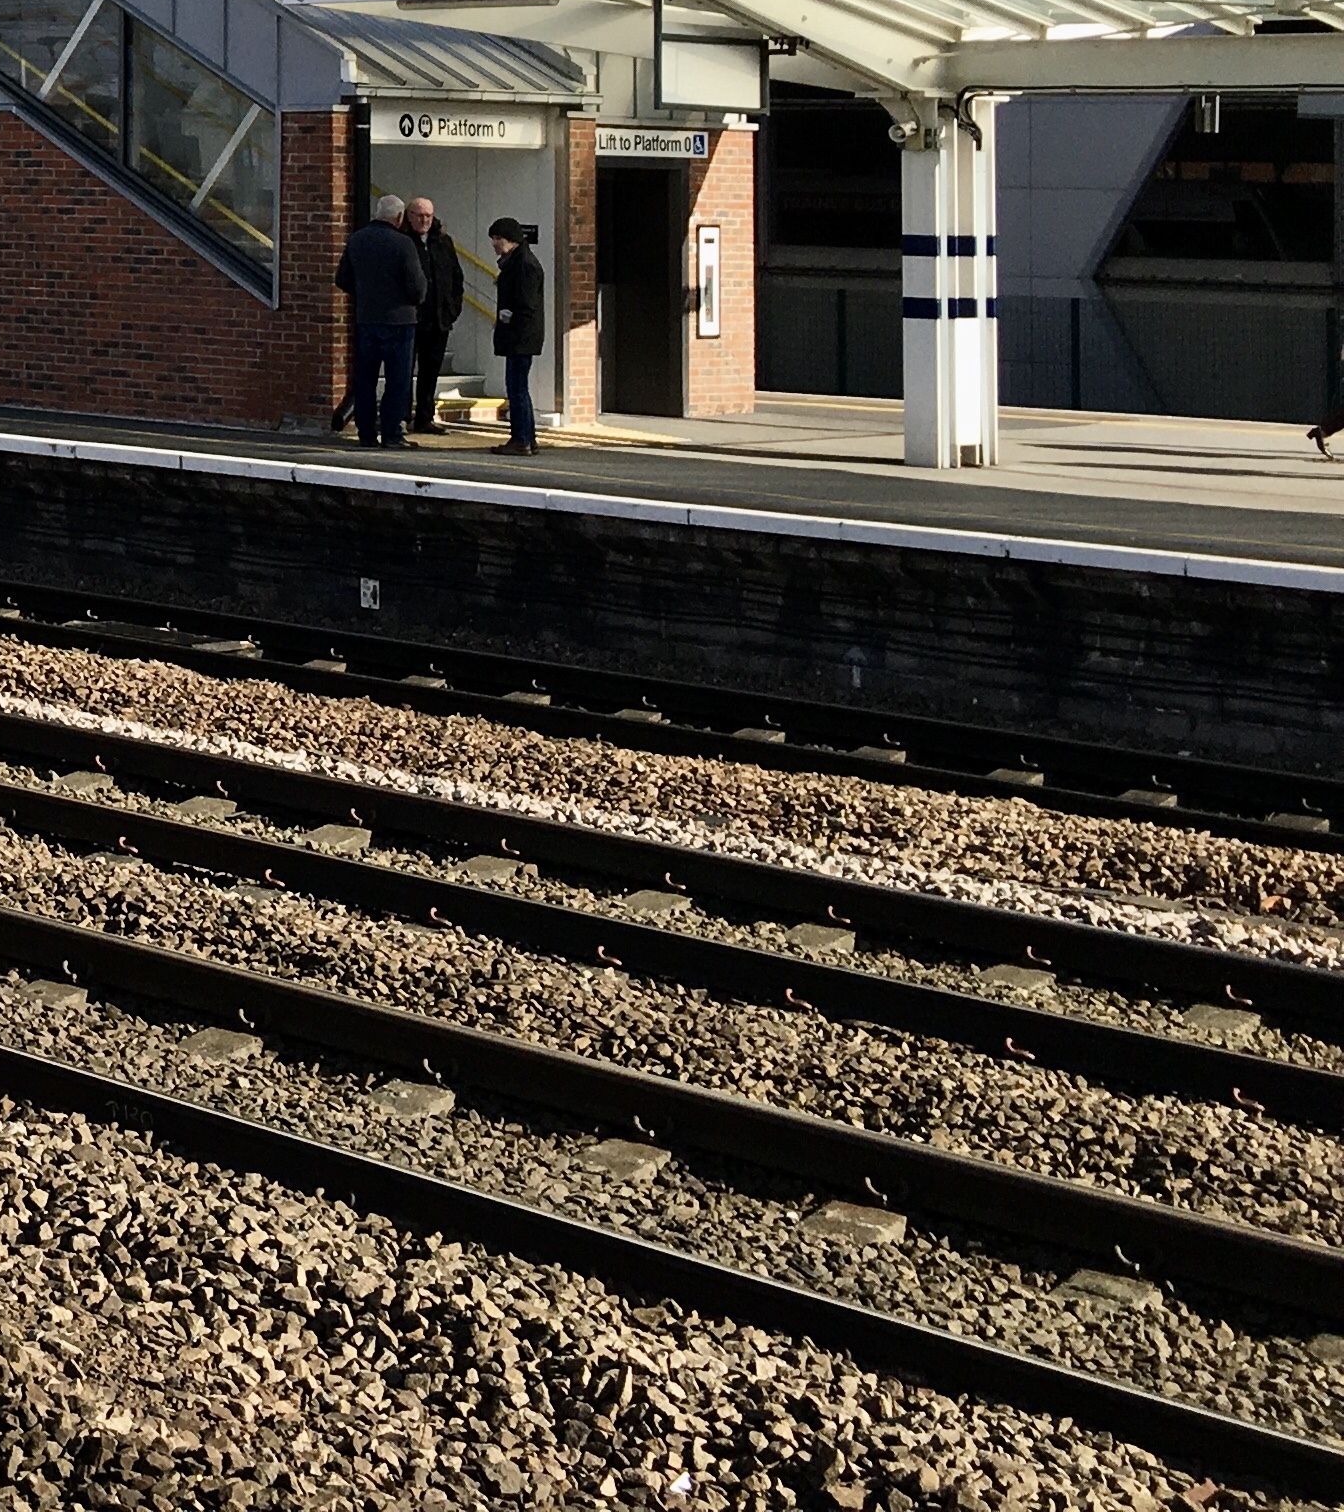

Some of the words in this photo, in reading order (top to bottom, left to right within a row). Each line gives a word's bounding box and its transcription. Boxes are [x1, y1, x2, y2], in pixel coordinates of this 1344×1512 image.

[438, 118, 494, 137] Platform
[498, 121, 506, 138] 0
[599, 134, 616, 150] Lift
[620, 135, 631, 151] to
[634, 135, 682, 152] Platform
[685, 136, 692, 152] 0
